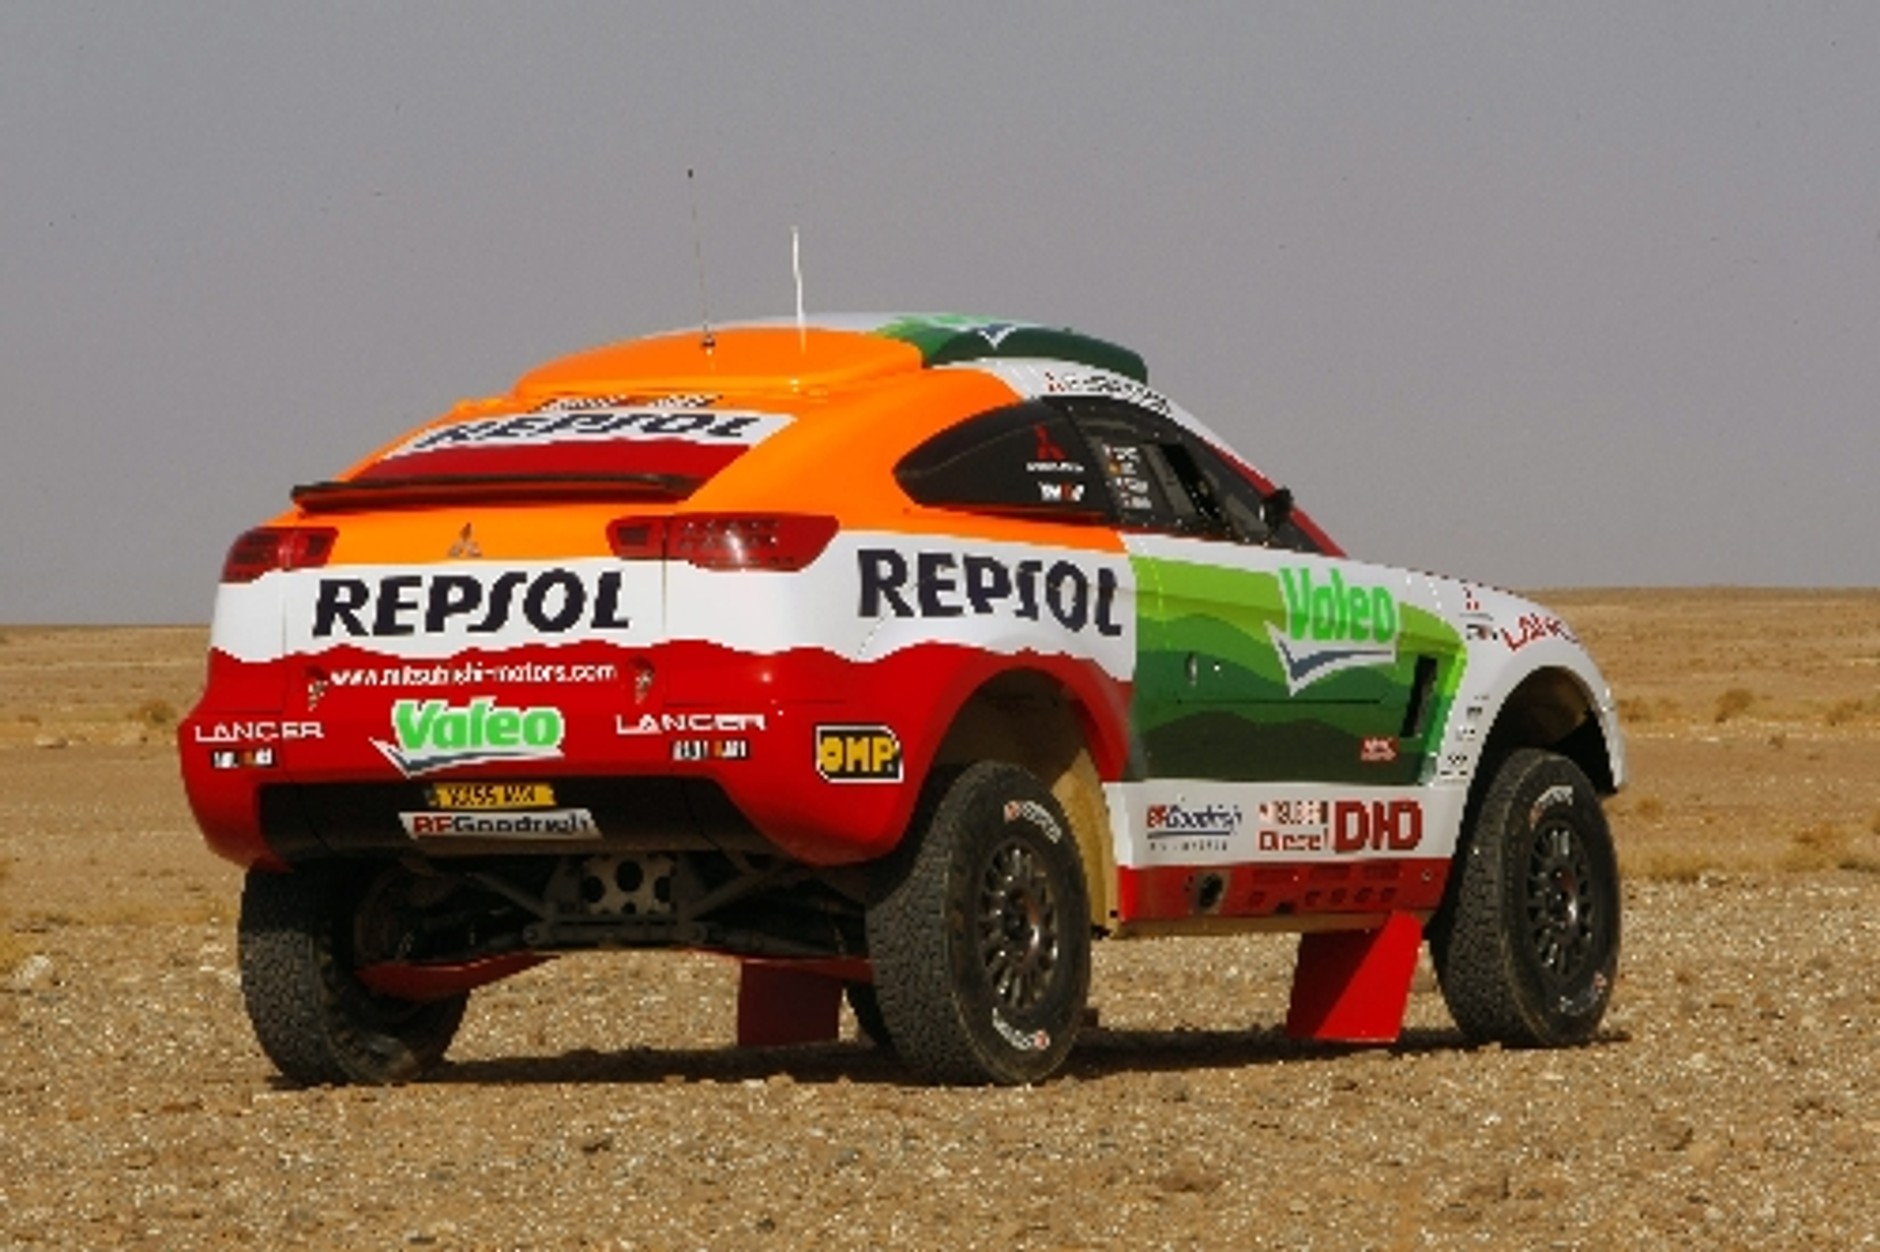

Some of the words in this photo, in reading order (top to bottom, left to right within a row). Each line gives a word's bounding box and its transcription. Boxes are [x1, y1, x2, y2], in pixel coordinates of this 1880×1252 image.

[414, 413, 760, 447] REPSOL
[313, 569, 629, 637] REPSOL
[858, 548, 1122, 636] REPSOL
[1280, 567, 1396, 642] Valeo
[195, 721, 325, 742] LANCER
[392, 696, 565, 751] Valeo
[615, 713, 767, 735] LANCER
[820, 736, 896, 772] OMP
